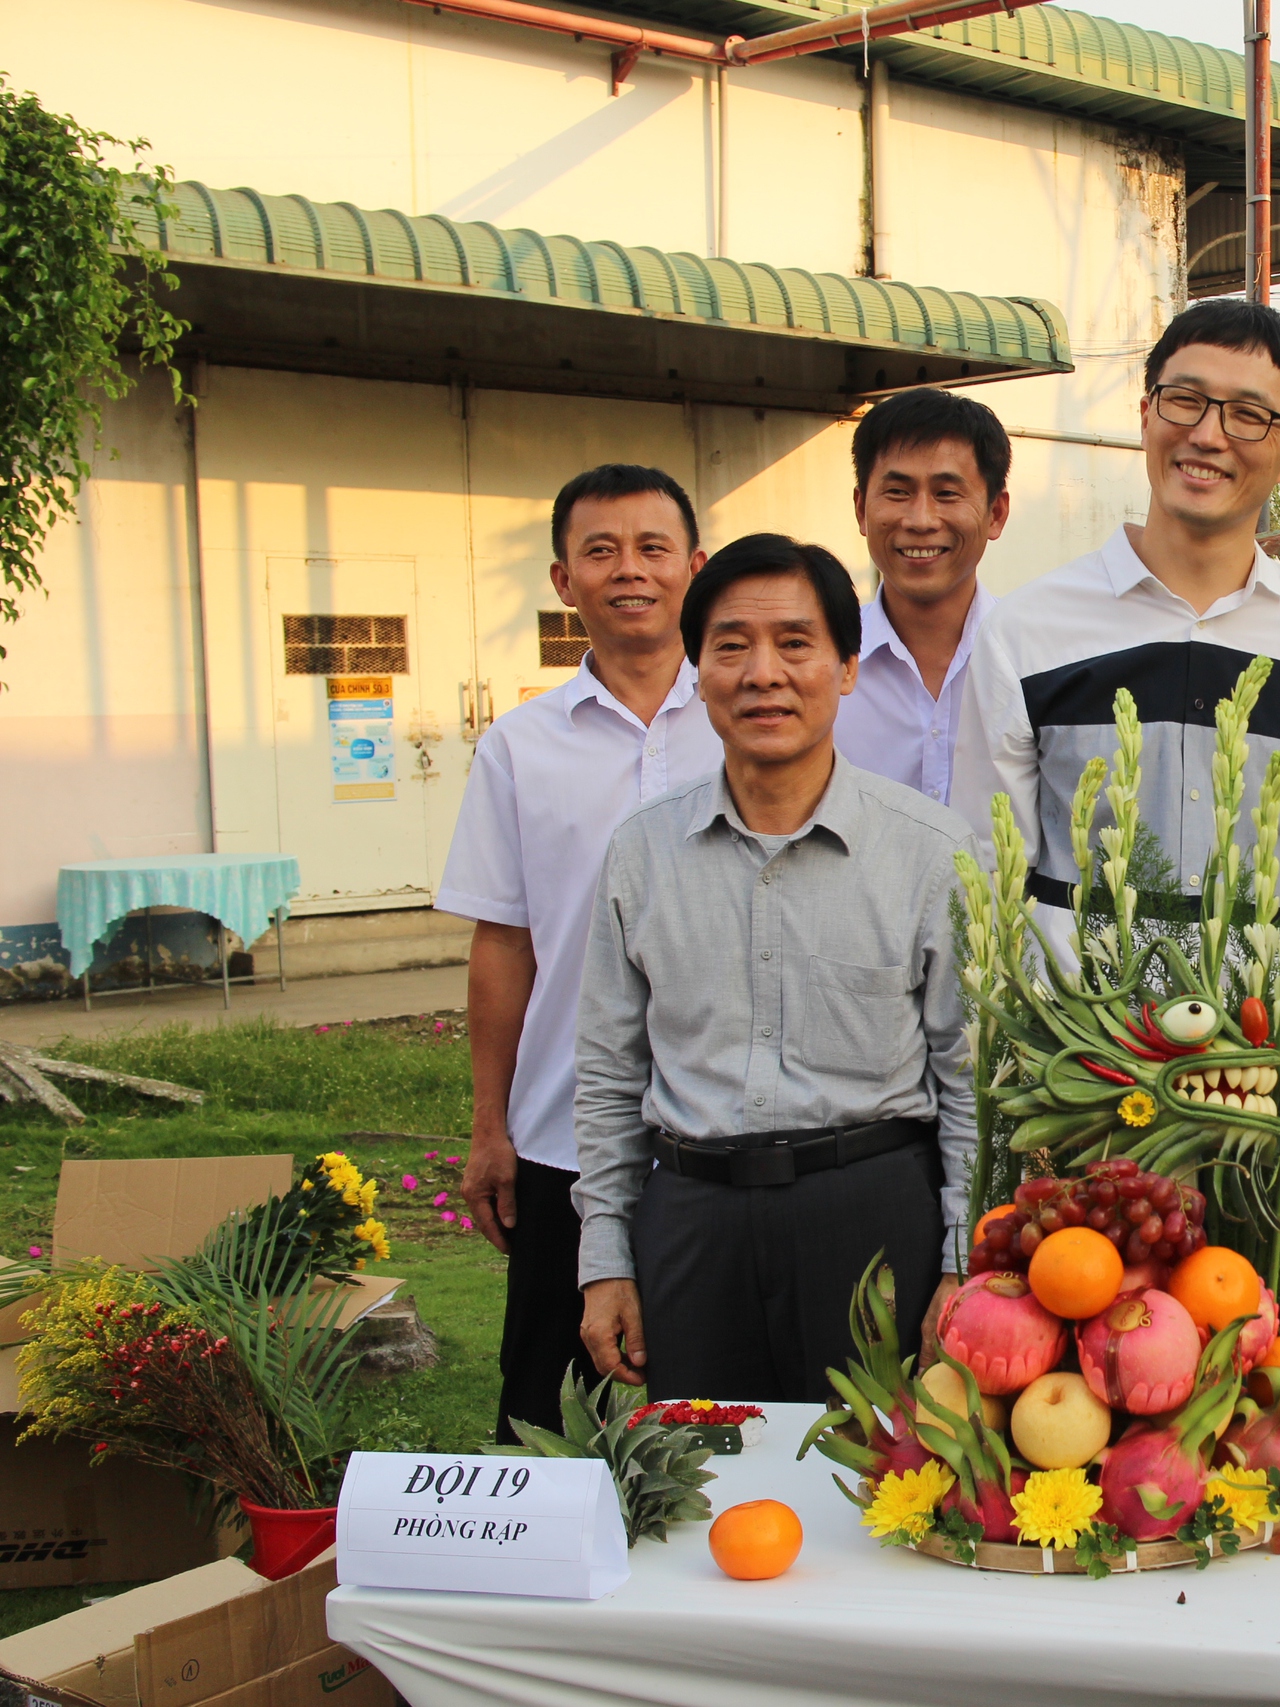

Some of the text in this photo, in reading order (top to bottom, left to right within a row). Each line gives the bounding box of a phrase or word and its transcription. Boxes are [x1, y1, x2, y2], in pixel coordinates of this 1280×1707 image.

[402, 1460, 531, 1504] ĐỘI 19
[393, 1513, 528, 1546] PHÒNG RẬP
